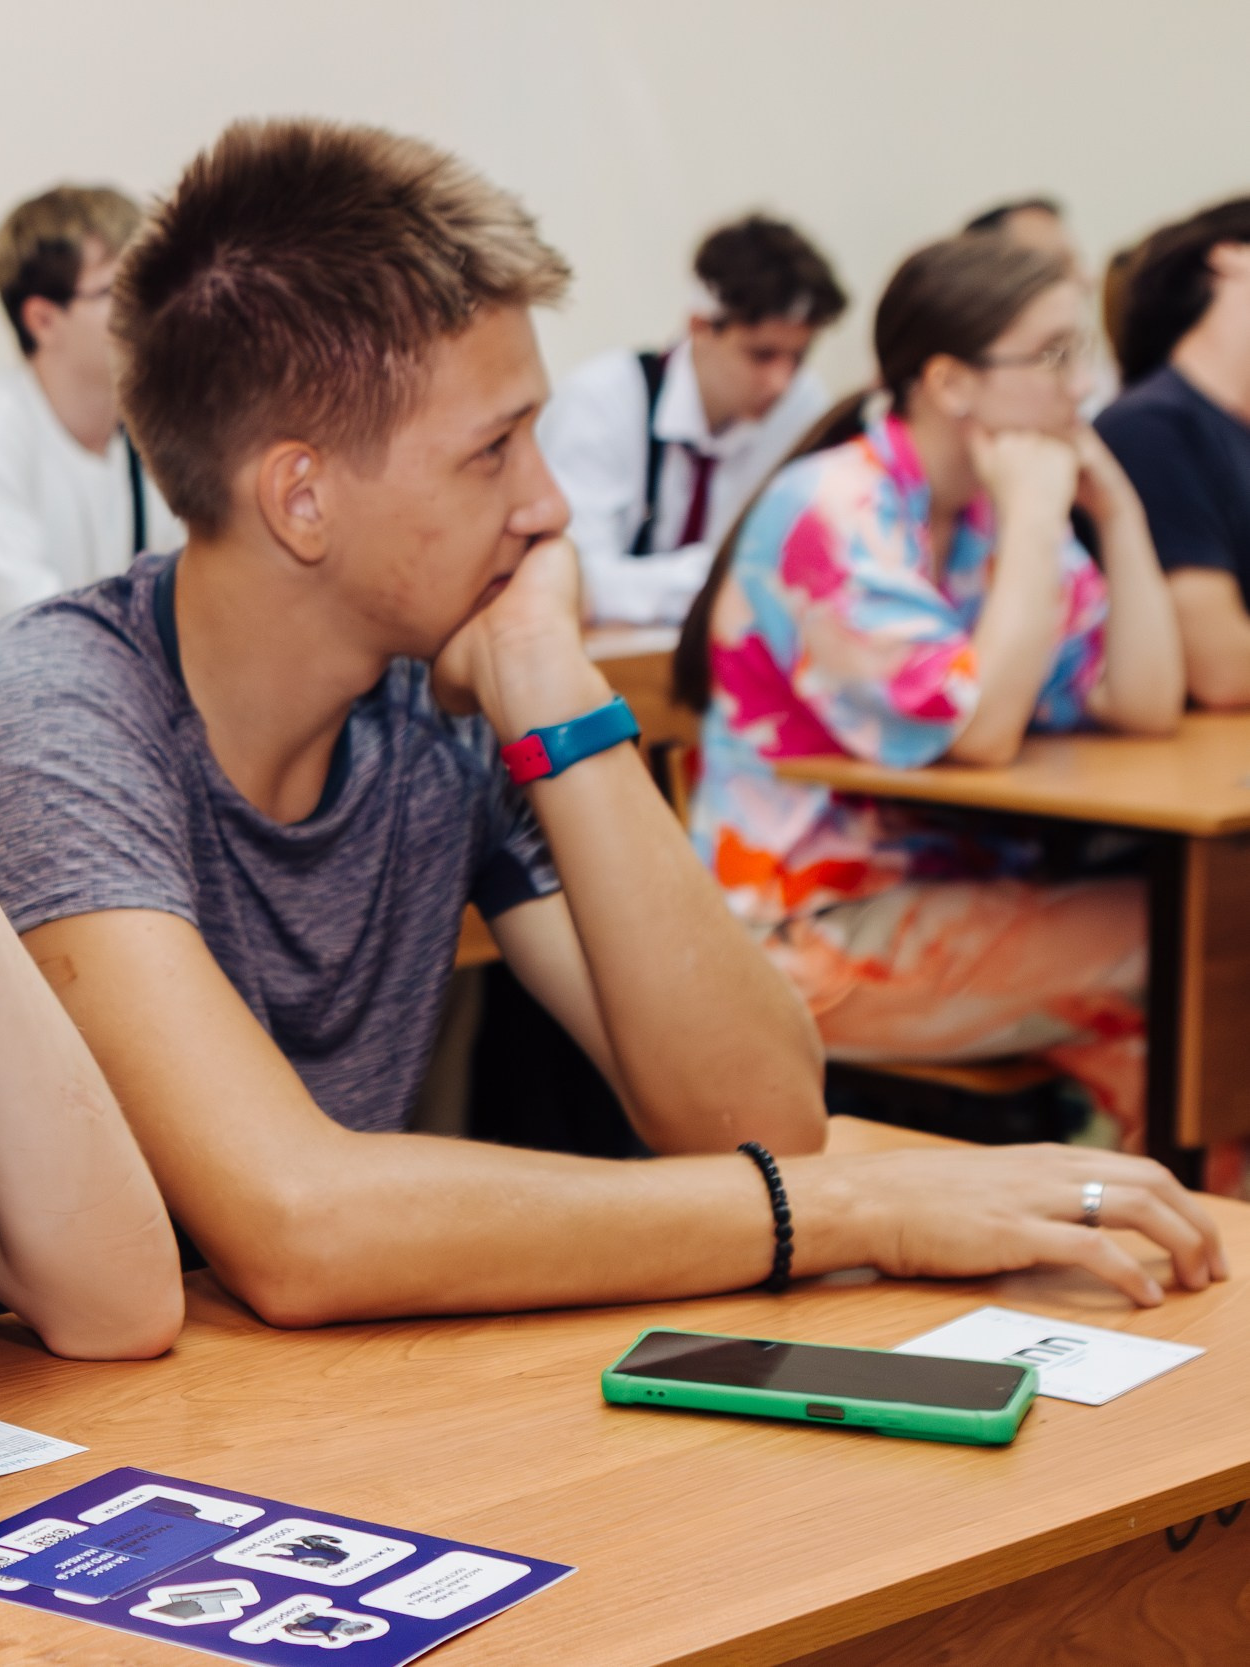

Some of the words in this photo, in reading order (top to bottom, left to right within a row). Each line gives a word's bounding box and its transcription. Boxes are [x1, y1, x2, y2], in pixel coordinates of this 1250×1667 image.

[81, 1548, 98, 1557] НА
[90, 1551, 113, 1563] ПРО
[111, 1555, 129, 1564] ЗА
